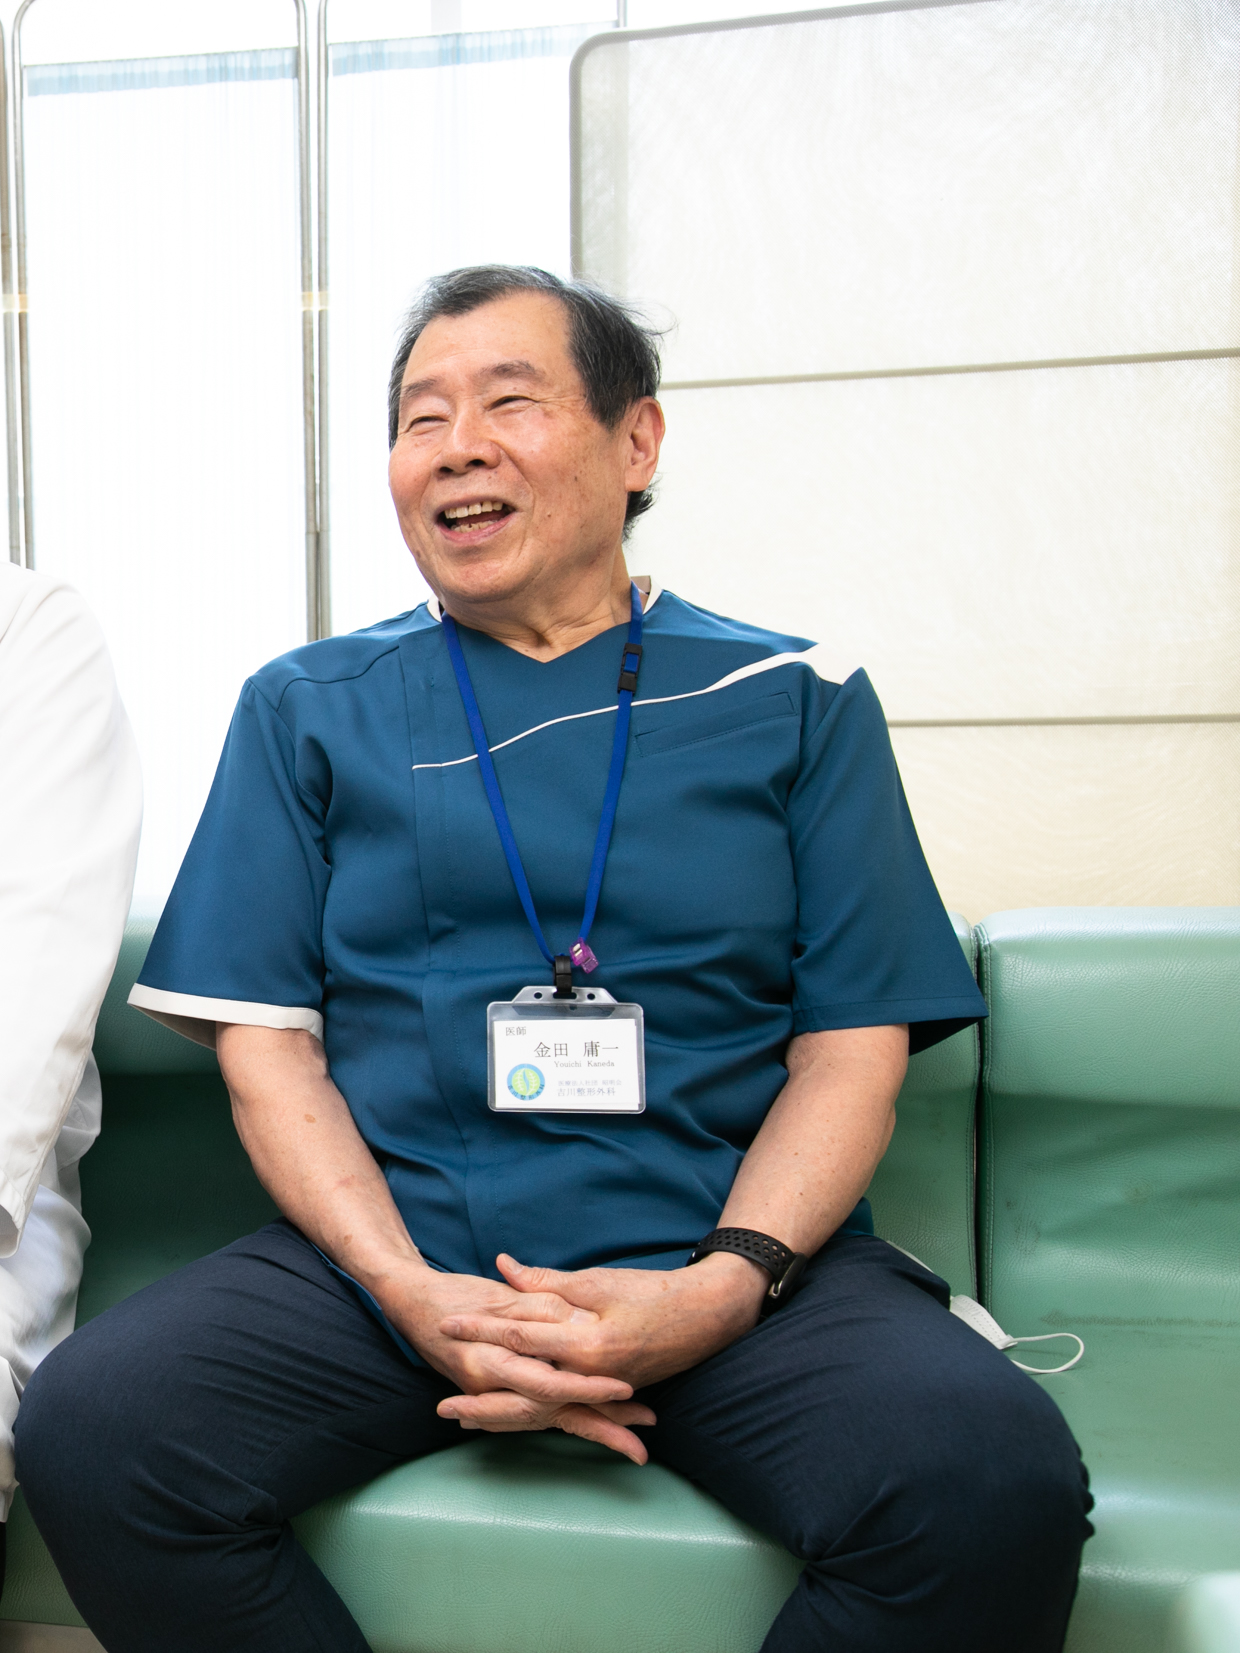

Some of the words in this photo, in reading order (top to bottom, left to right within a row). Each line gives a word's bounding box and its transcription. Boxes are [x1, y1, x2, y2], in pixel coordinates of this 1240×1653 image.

[505, 1026, 527, 1037] 医師
[533, 1041, 569, 1058] 金田
[583, 1041, 619, 1058] 庸一
[587, 1060, 615, 1068] Kaneda
